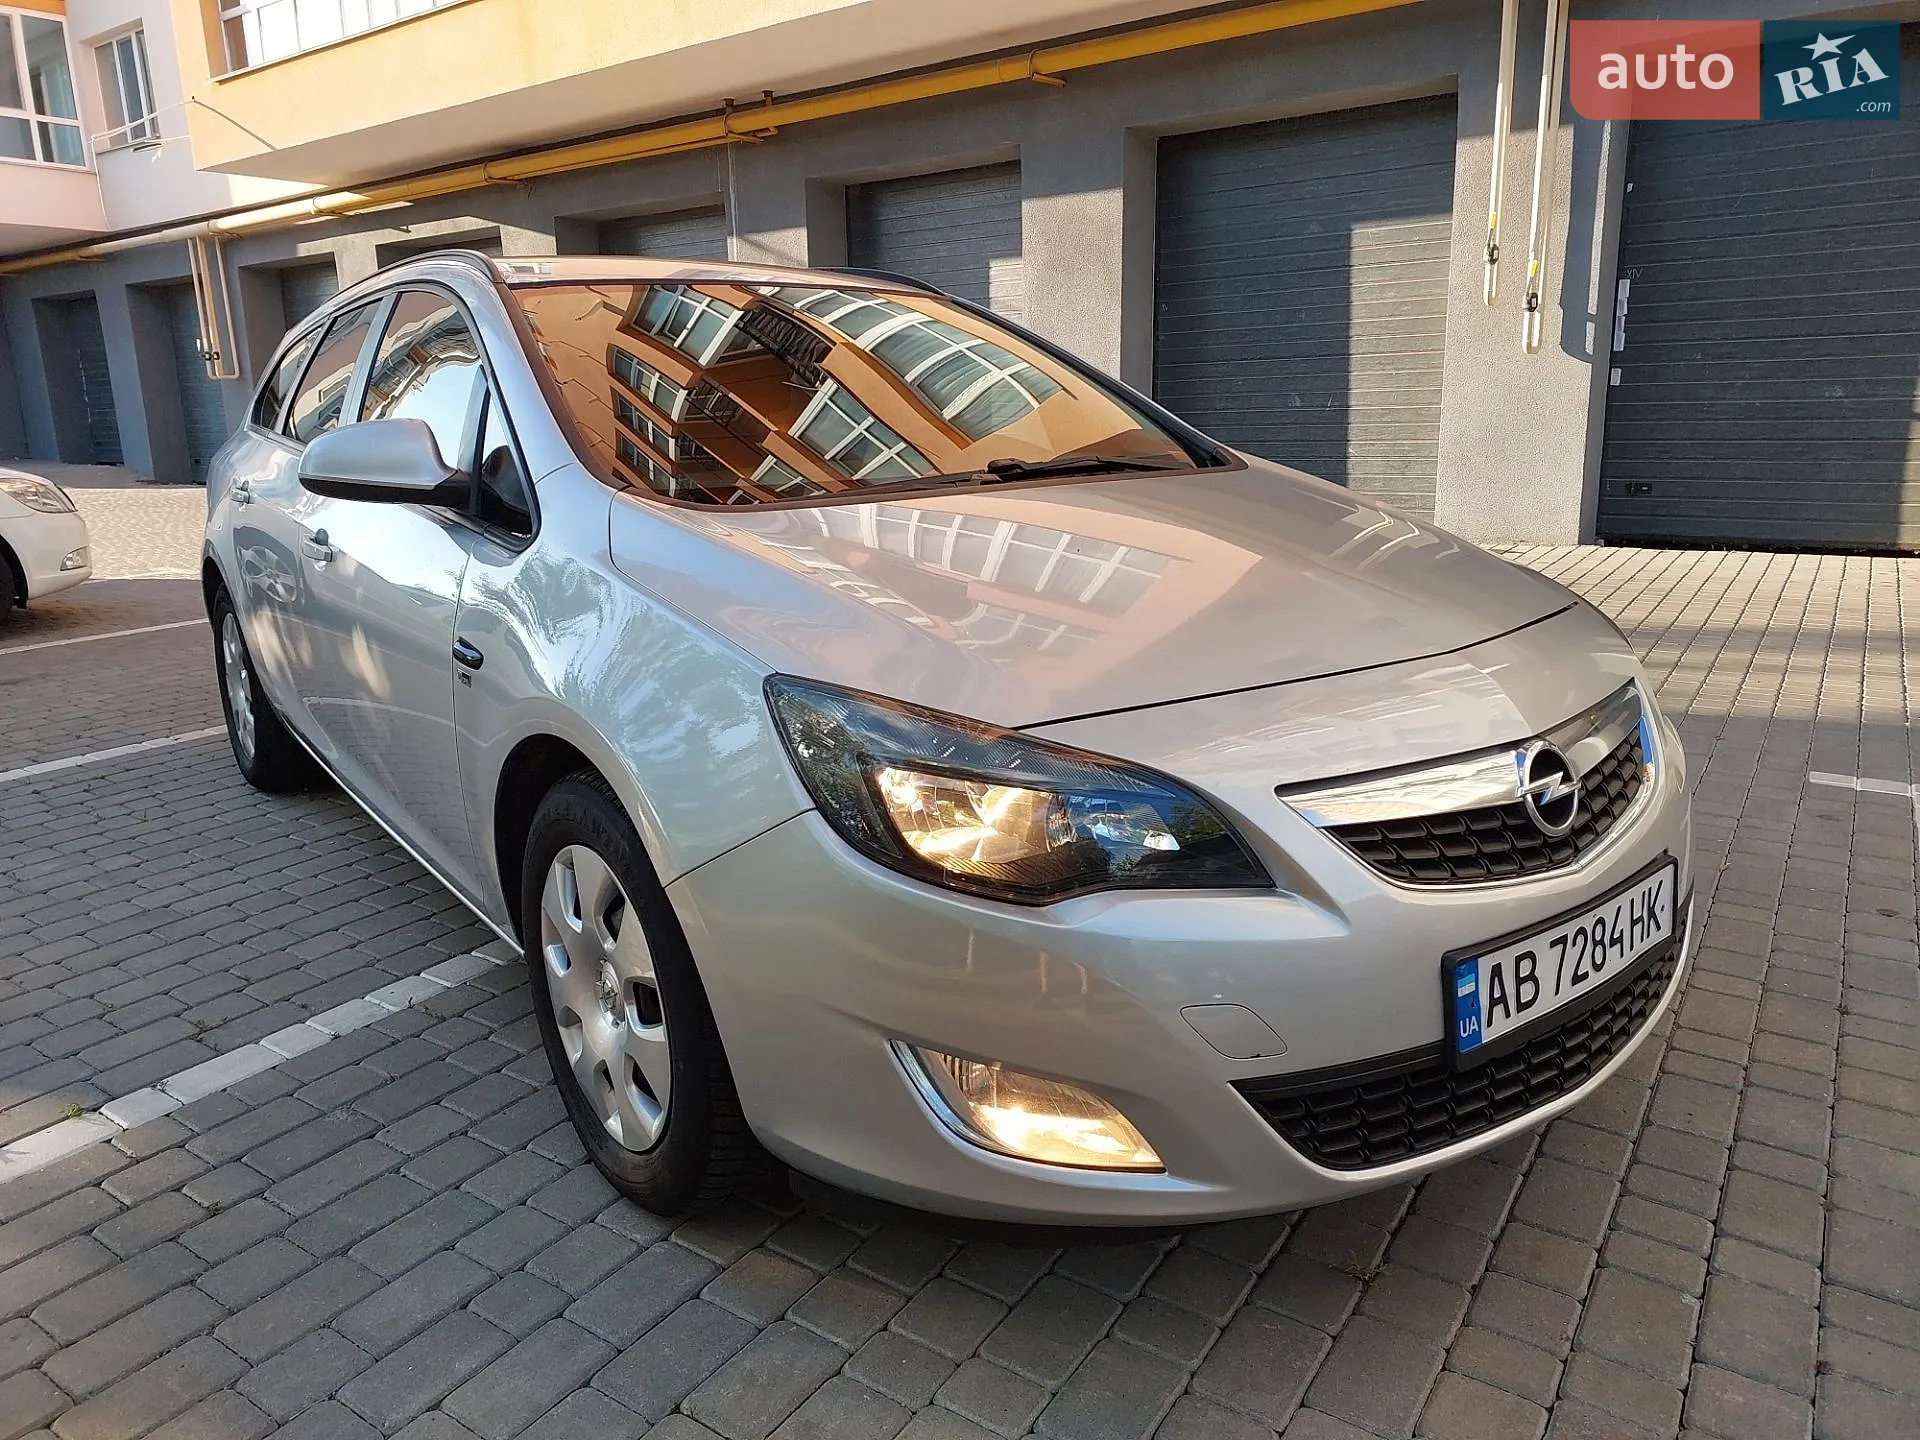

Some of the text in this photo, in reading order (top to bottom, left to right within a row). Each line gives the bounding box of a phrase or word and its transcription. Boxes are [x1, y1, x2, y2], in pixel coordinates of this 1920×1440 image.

[1486, 880, 1664, 1028] AB 7284 HK
[1460, 1017, 1479, 1038] UA
